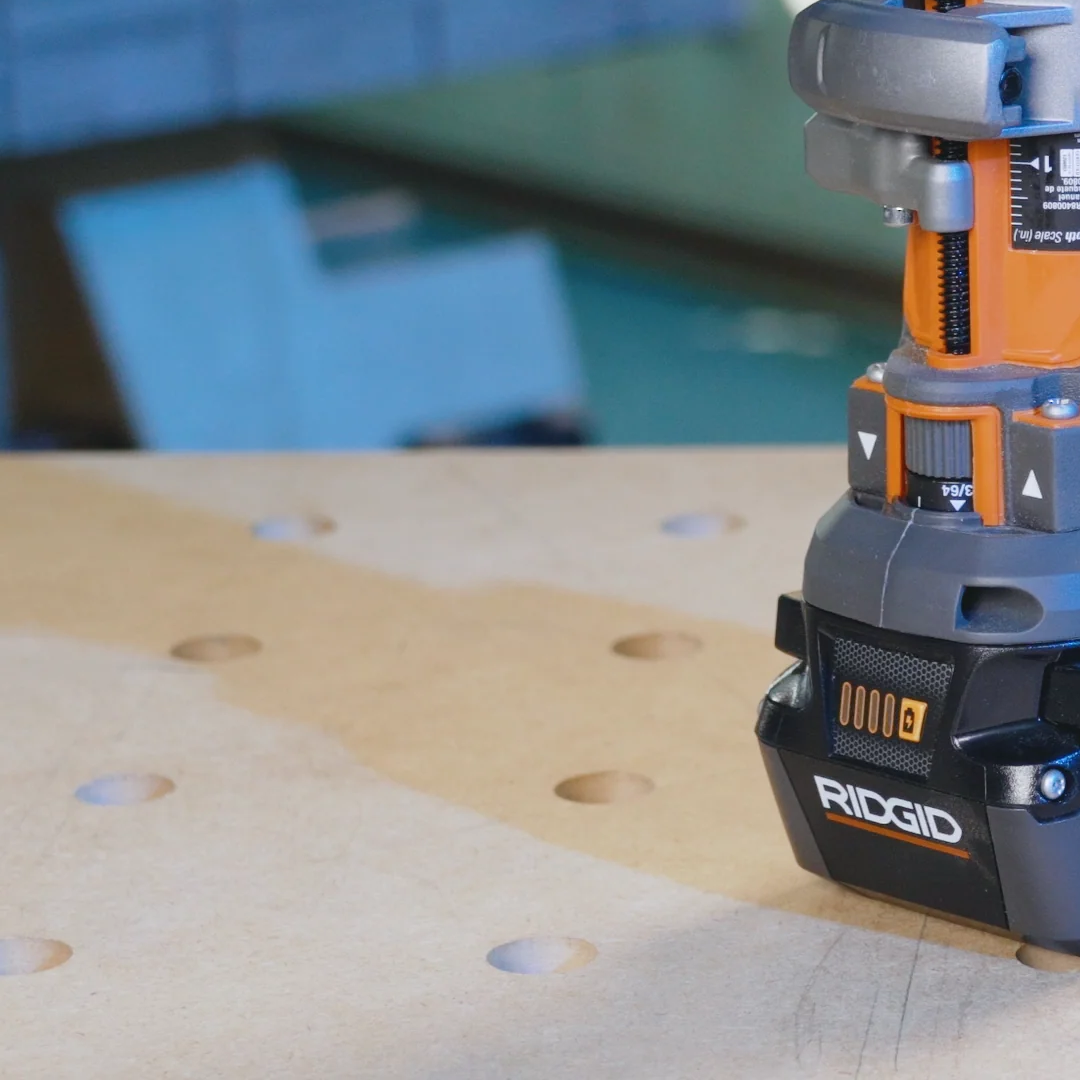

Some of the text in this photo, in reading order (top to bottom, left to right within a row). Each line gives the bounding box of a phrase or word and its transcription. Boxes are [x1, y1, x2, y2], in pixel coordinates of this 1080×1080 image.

[1044, 156, 1052, 173] 1
[1014, 229, 1033, 241] (in.)
[1035, 231, 1062, 243] Scale
[942, 484, 973, 497] 3/64
[814, 775, 962, 843] RIDGID
